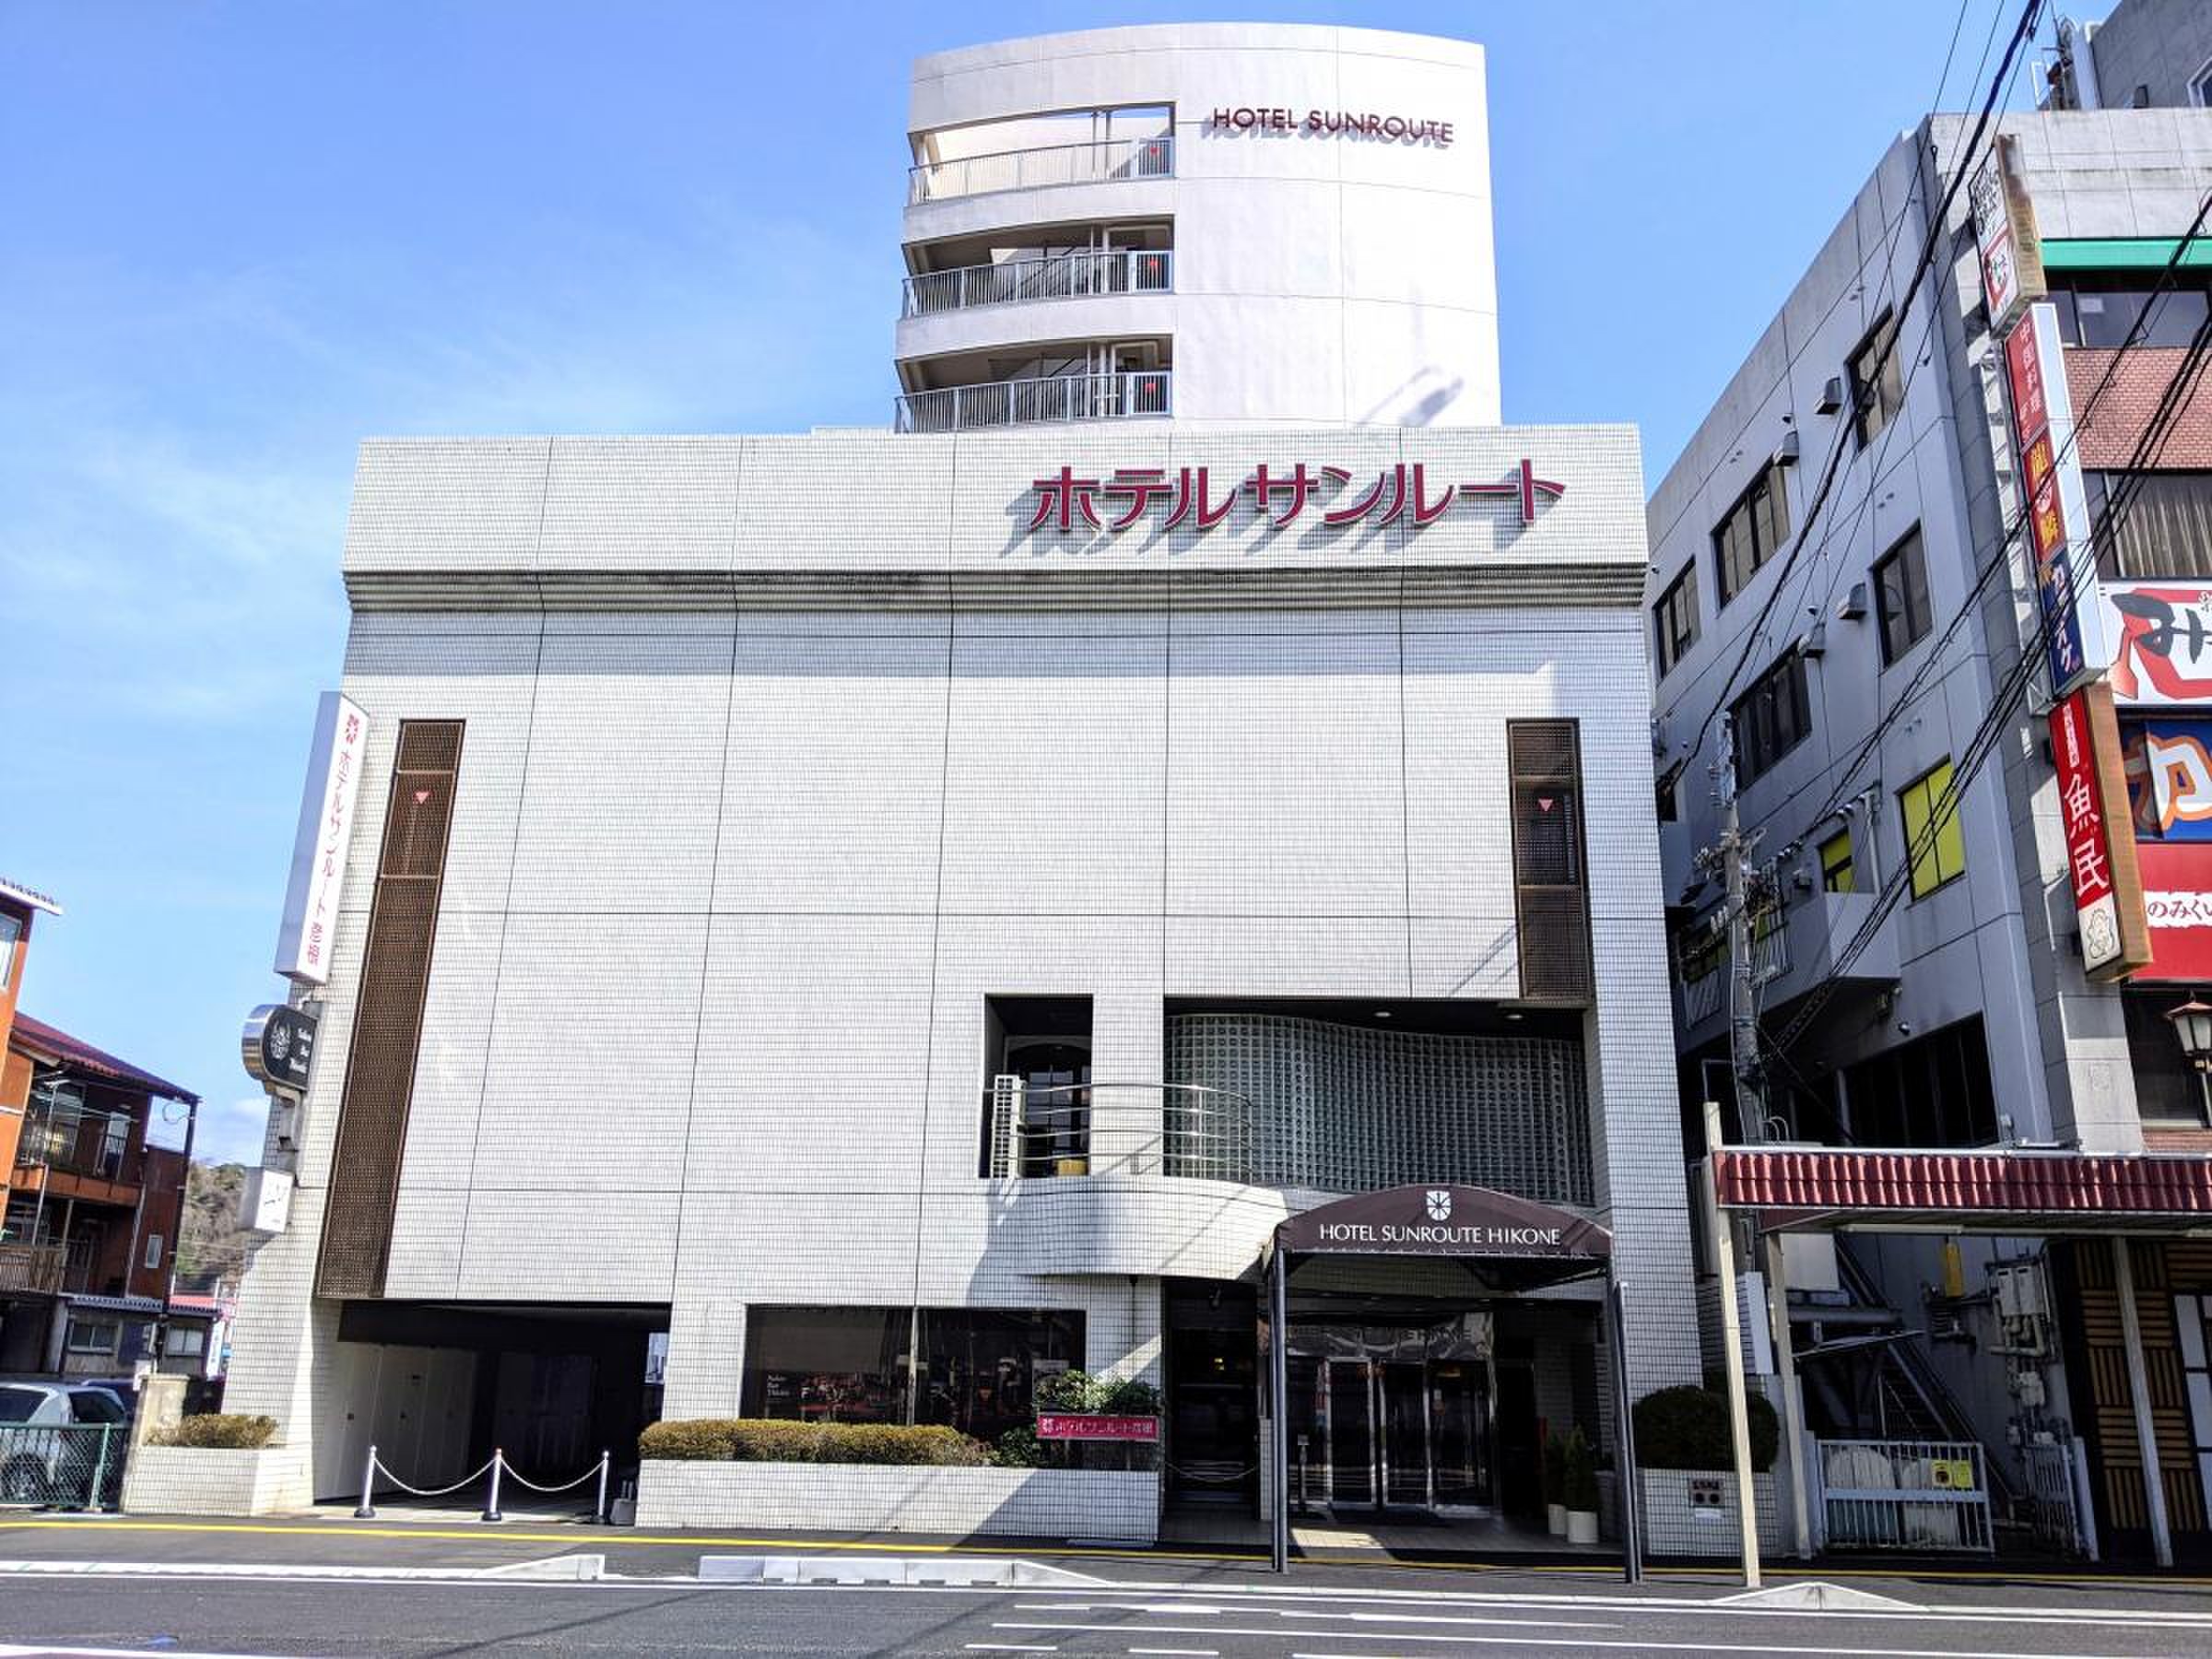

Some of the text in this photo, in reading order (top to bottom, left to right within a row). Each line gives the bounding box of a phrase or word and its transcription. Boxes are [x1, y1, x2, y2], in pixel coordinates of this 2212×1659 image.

[1214, 108, 1453, 144] HOTEL SUNROUTE
[1030, 459, 1566, 529] ホテルサンルート
[2064, 773, 2109, 897] 魚民
[1319, 1225, 1561, 1246] HOTEL SUNROUTE HIKONE
